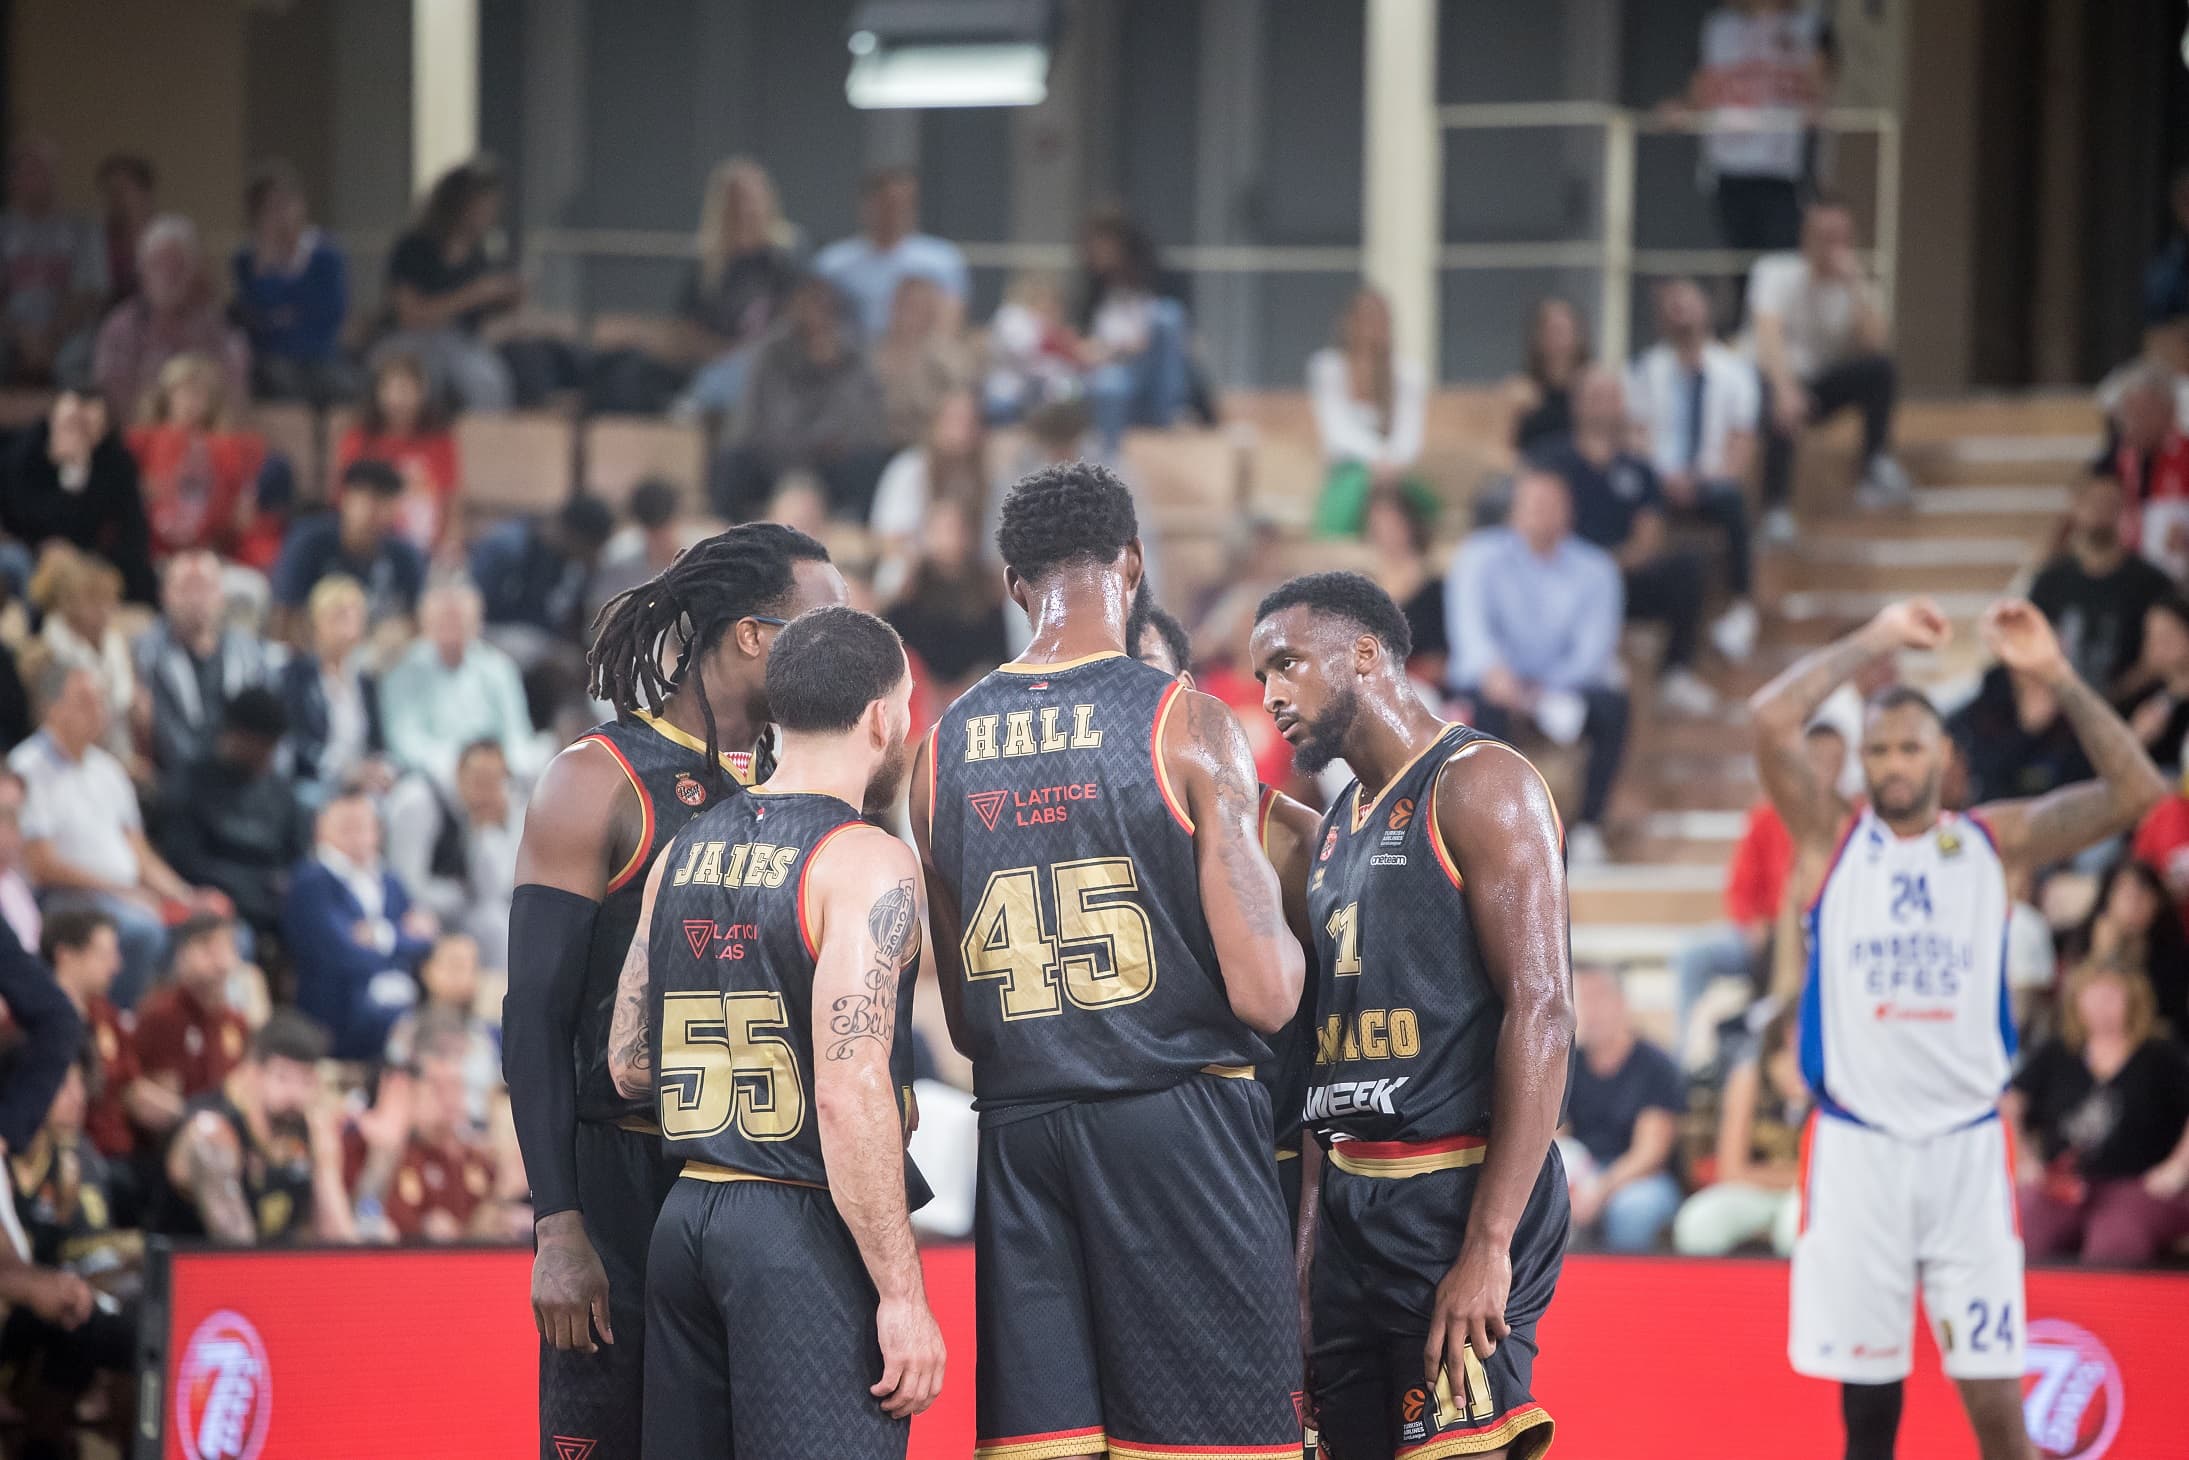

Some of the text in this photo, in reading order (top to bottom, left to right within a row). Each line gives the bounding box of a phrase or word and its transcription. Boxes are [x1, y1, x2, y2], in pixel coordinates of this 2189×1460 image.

[965, 704, 1103, 763] HALL
[1014, 783, 1097, 807] LATTICE
[1016, 805, 1068, 827] LABS
[1891, 873, 1933, 922] 24
[960, 857, 1157, 1023] 45
[660, 990, 806, 1143] 55
[1968, 1301, 2015, 1352] 24
